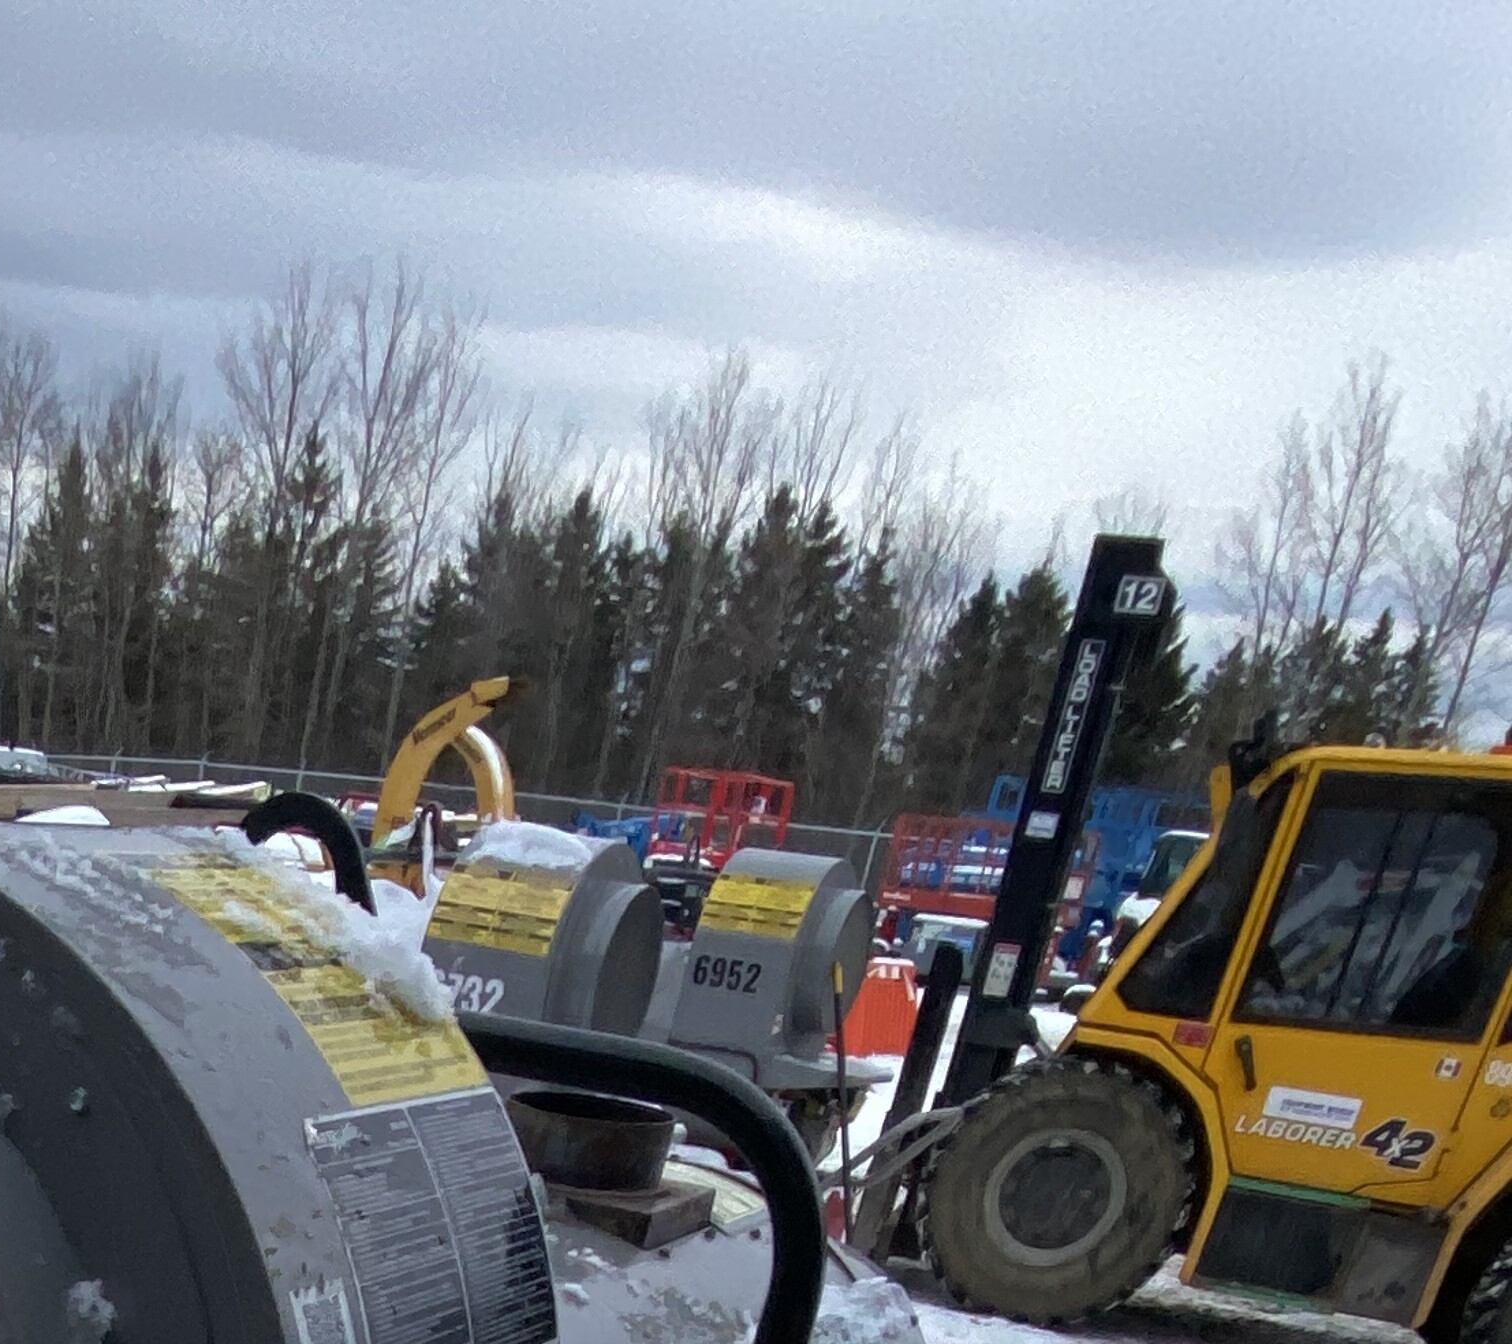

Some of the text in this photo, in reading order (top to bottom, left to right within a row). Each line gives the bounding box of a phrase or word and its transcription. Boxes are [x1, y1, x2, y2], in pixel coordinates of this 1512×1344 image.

[1124, 581, 1159, 612] 12
[1045, 643, 1097, 789] LOAD LIFTER
[693, 954, 762, 994] 6952
[1234, 1115, 1357, 1150] LABORER
